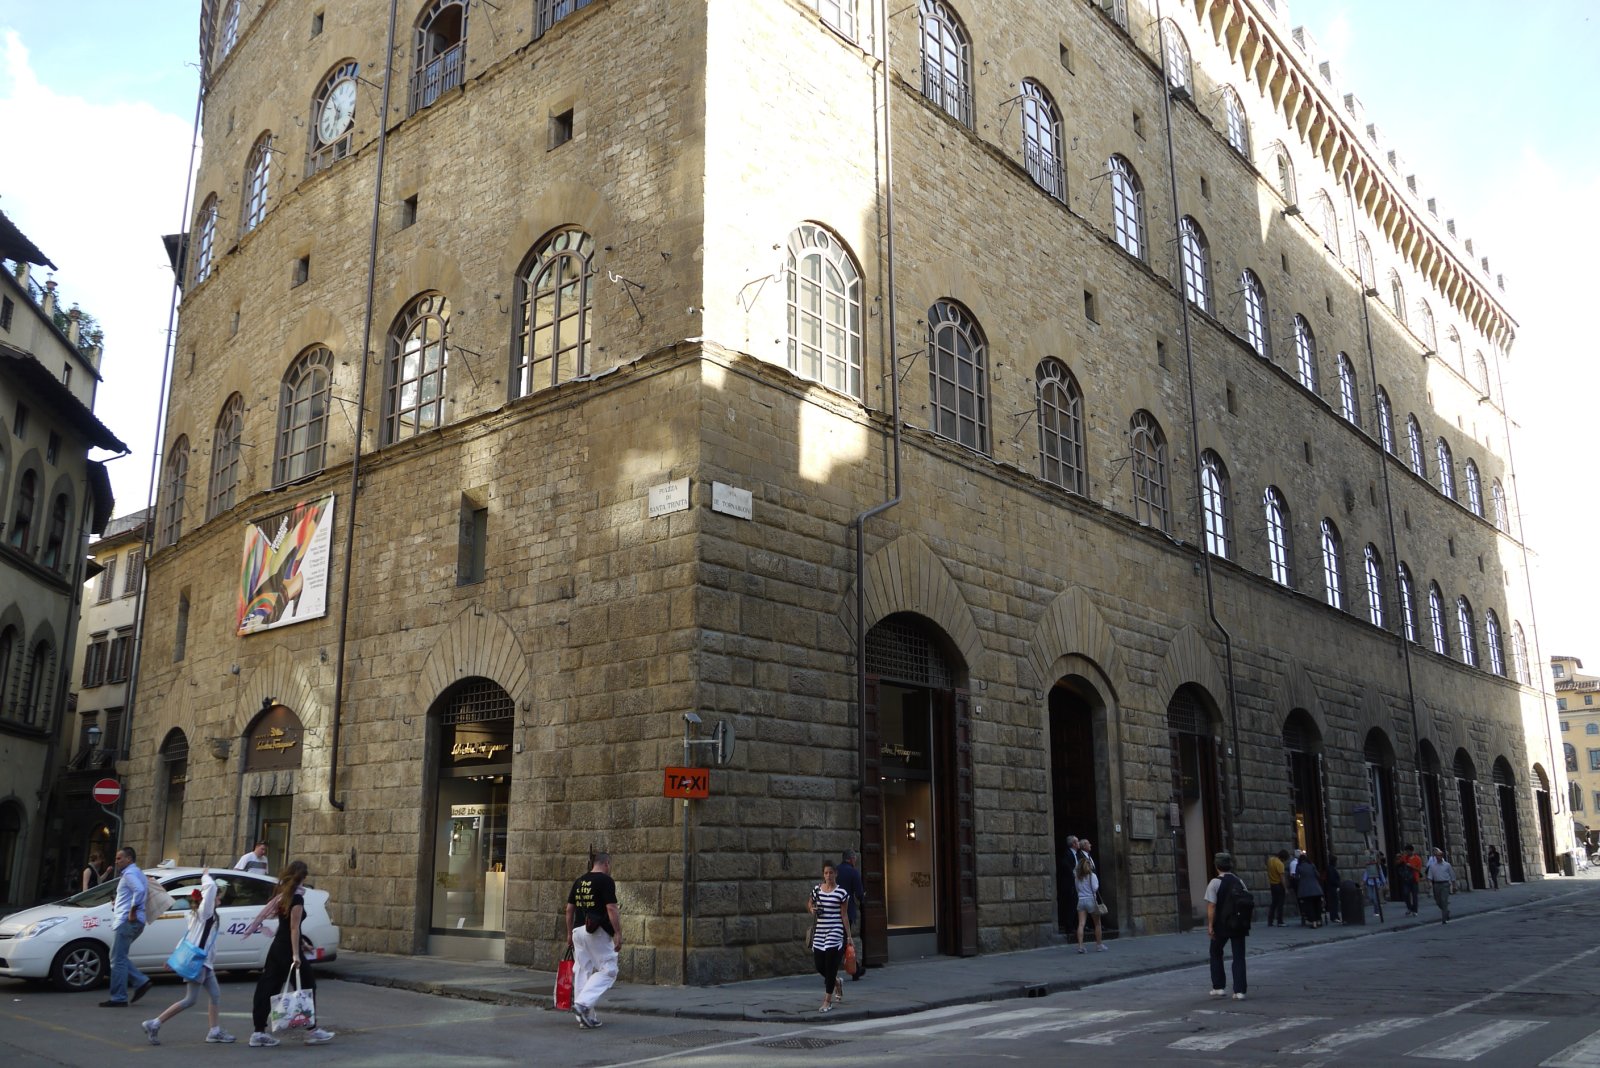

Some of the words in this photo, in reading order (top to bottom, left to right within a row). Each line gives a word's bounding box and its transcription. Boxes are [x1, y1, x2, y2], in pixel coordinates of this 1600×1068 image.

[658, 484, 678, 495] PIAZZA
[649, 504, 666, 514] SANTA
[668, 775, 706, 791] TAXI
